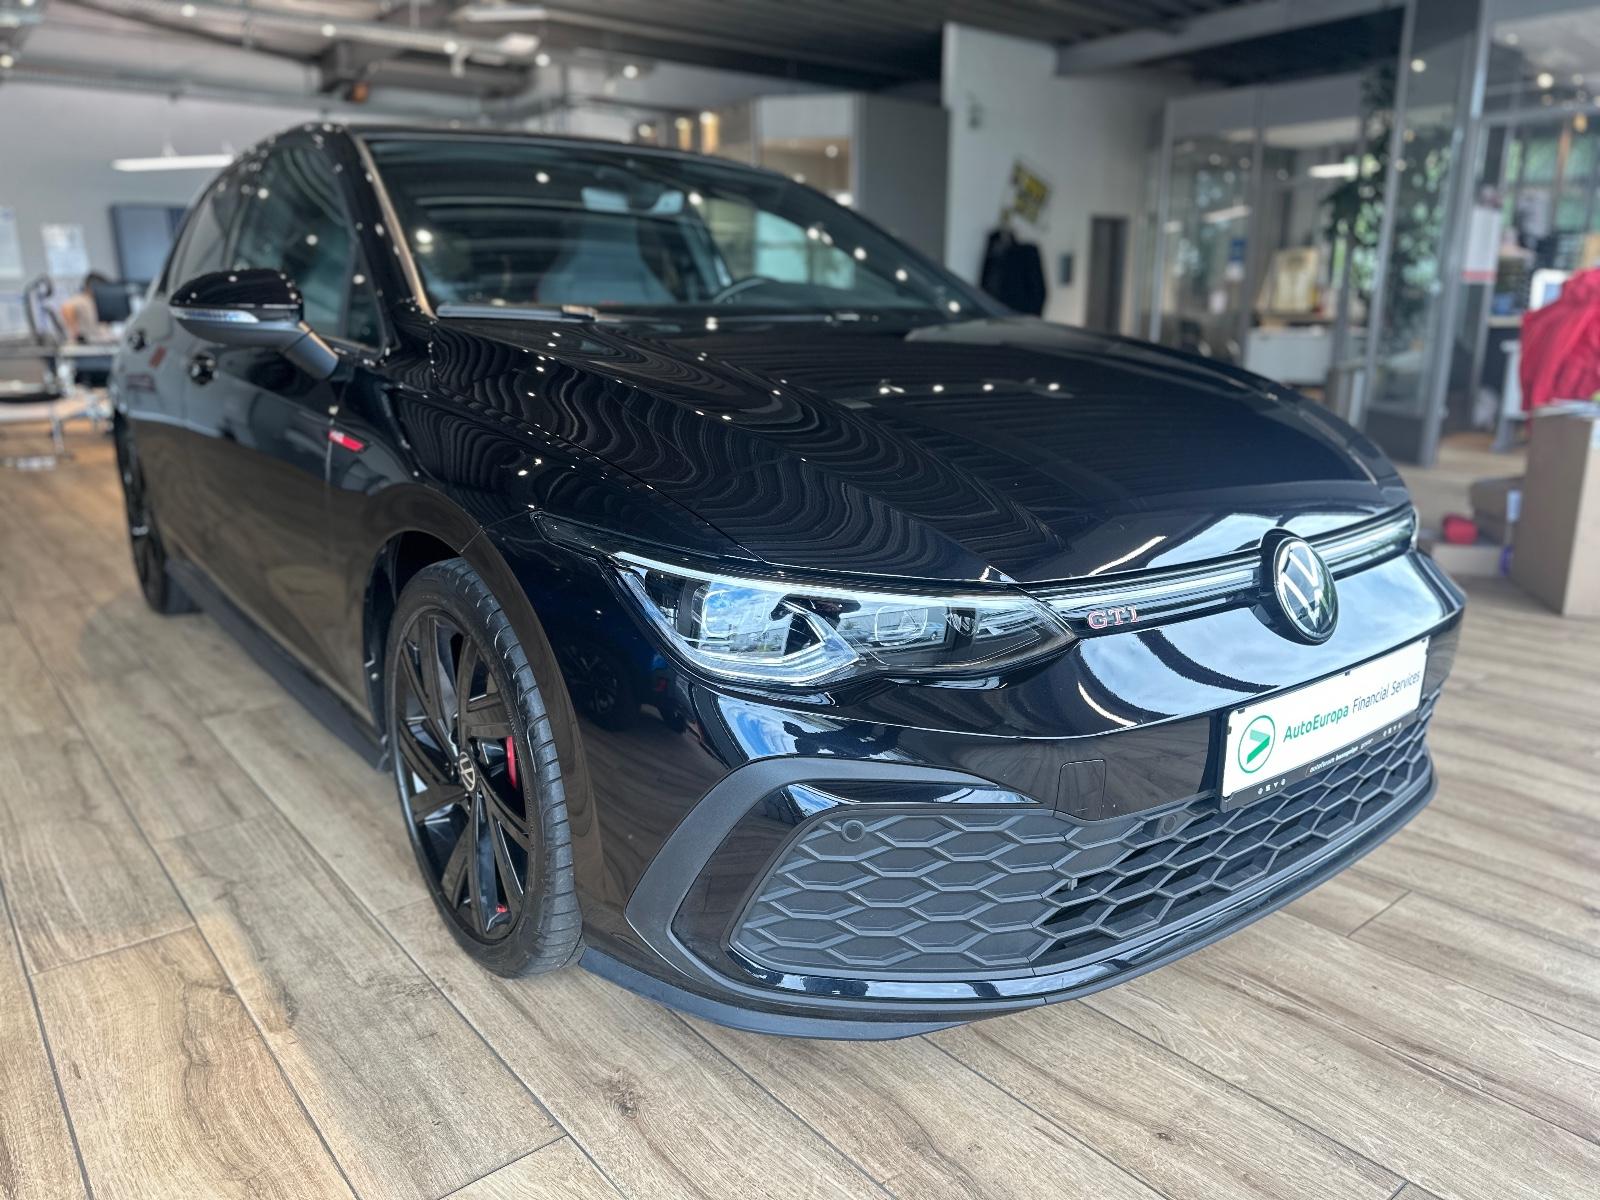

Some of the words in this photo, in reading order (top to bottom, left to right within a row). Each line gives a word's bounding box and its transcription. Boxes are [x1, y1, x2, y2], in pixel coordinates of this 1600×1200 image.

[1088, 605, 1138, 629] GTI
[1283, 704, 1349, 743] AutoEuropa
[1352, 684, 1389, 714] Financial
[1391, 670, 1421, 696] Services
